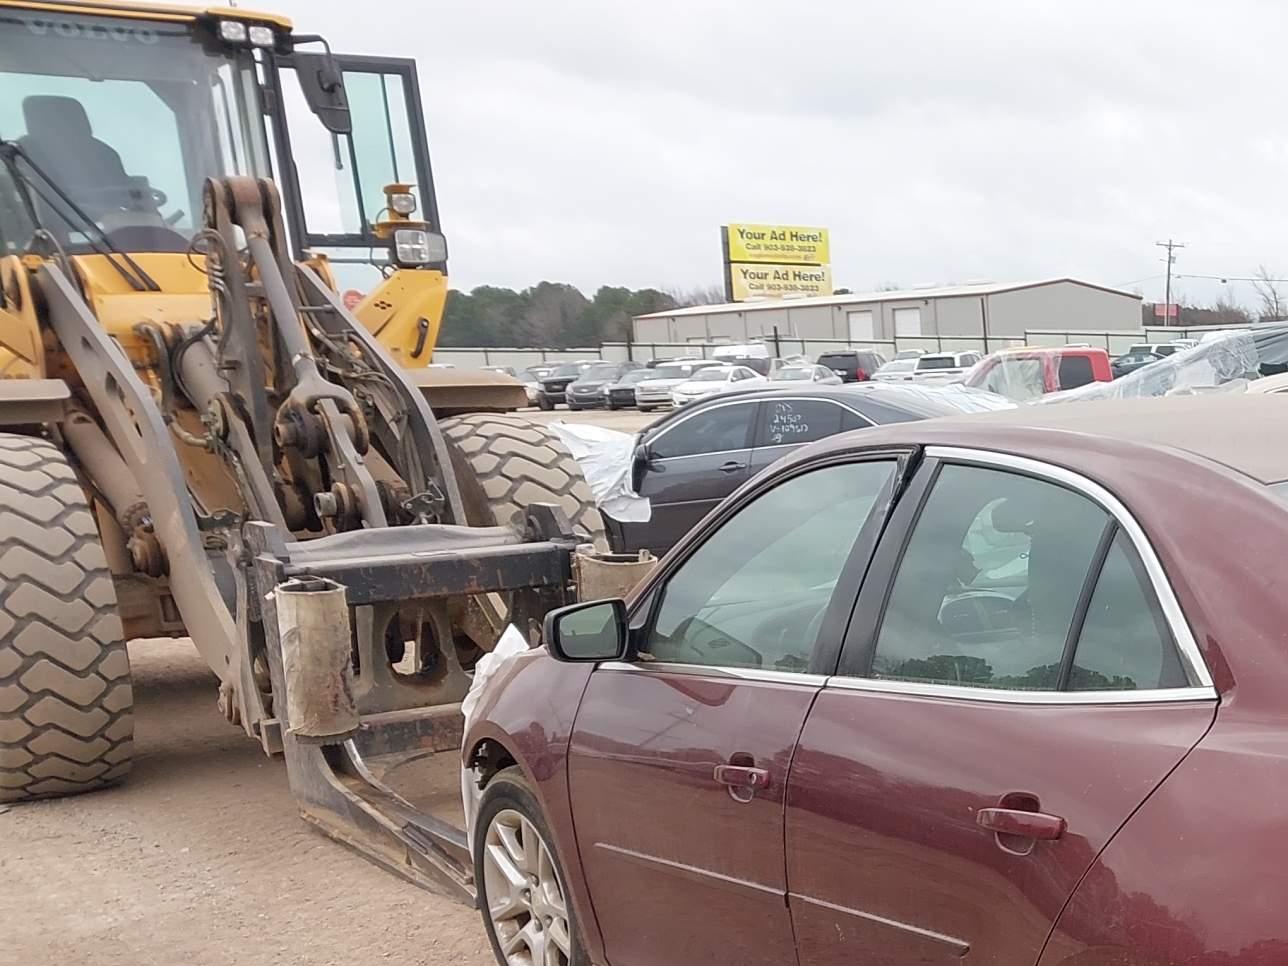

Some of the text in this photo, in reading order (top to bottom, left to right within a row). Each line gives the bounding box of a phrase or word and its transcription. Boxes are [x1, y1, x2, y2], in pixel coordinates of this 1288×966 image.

[737, 229, 823, 242] Your Ad Here!
[745, 243, 762, 251] Call
[740, 268, 825, 282] Your Ad Here!
